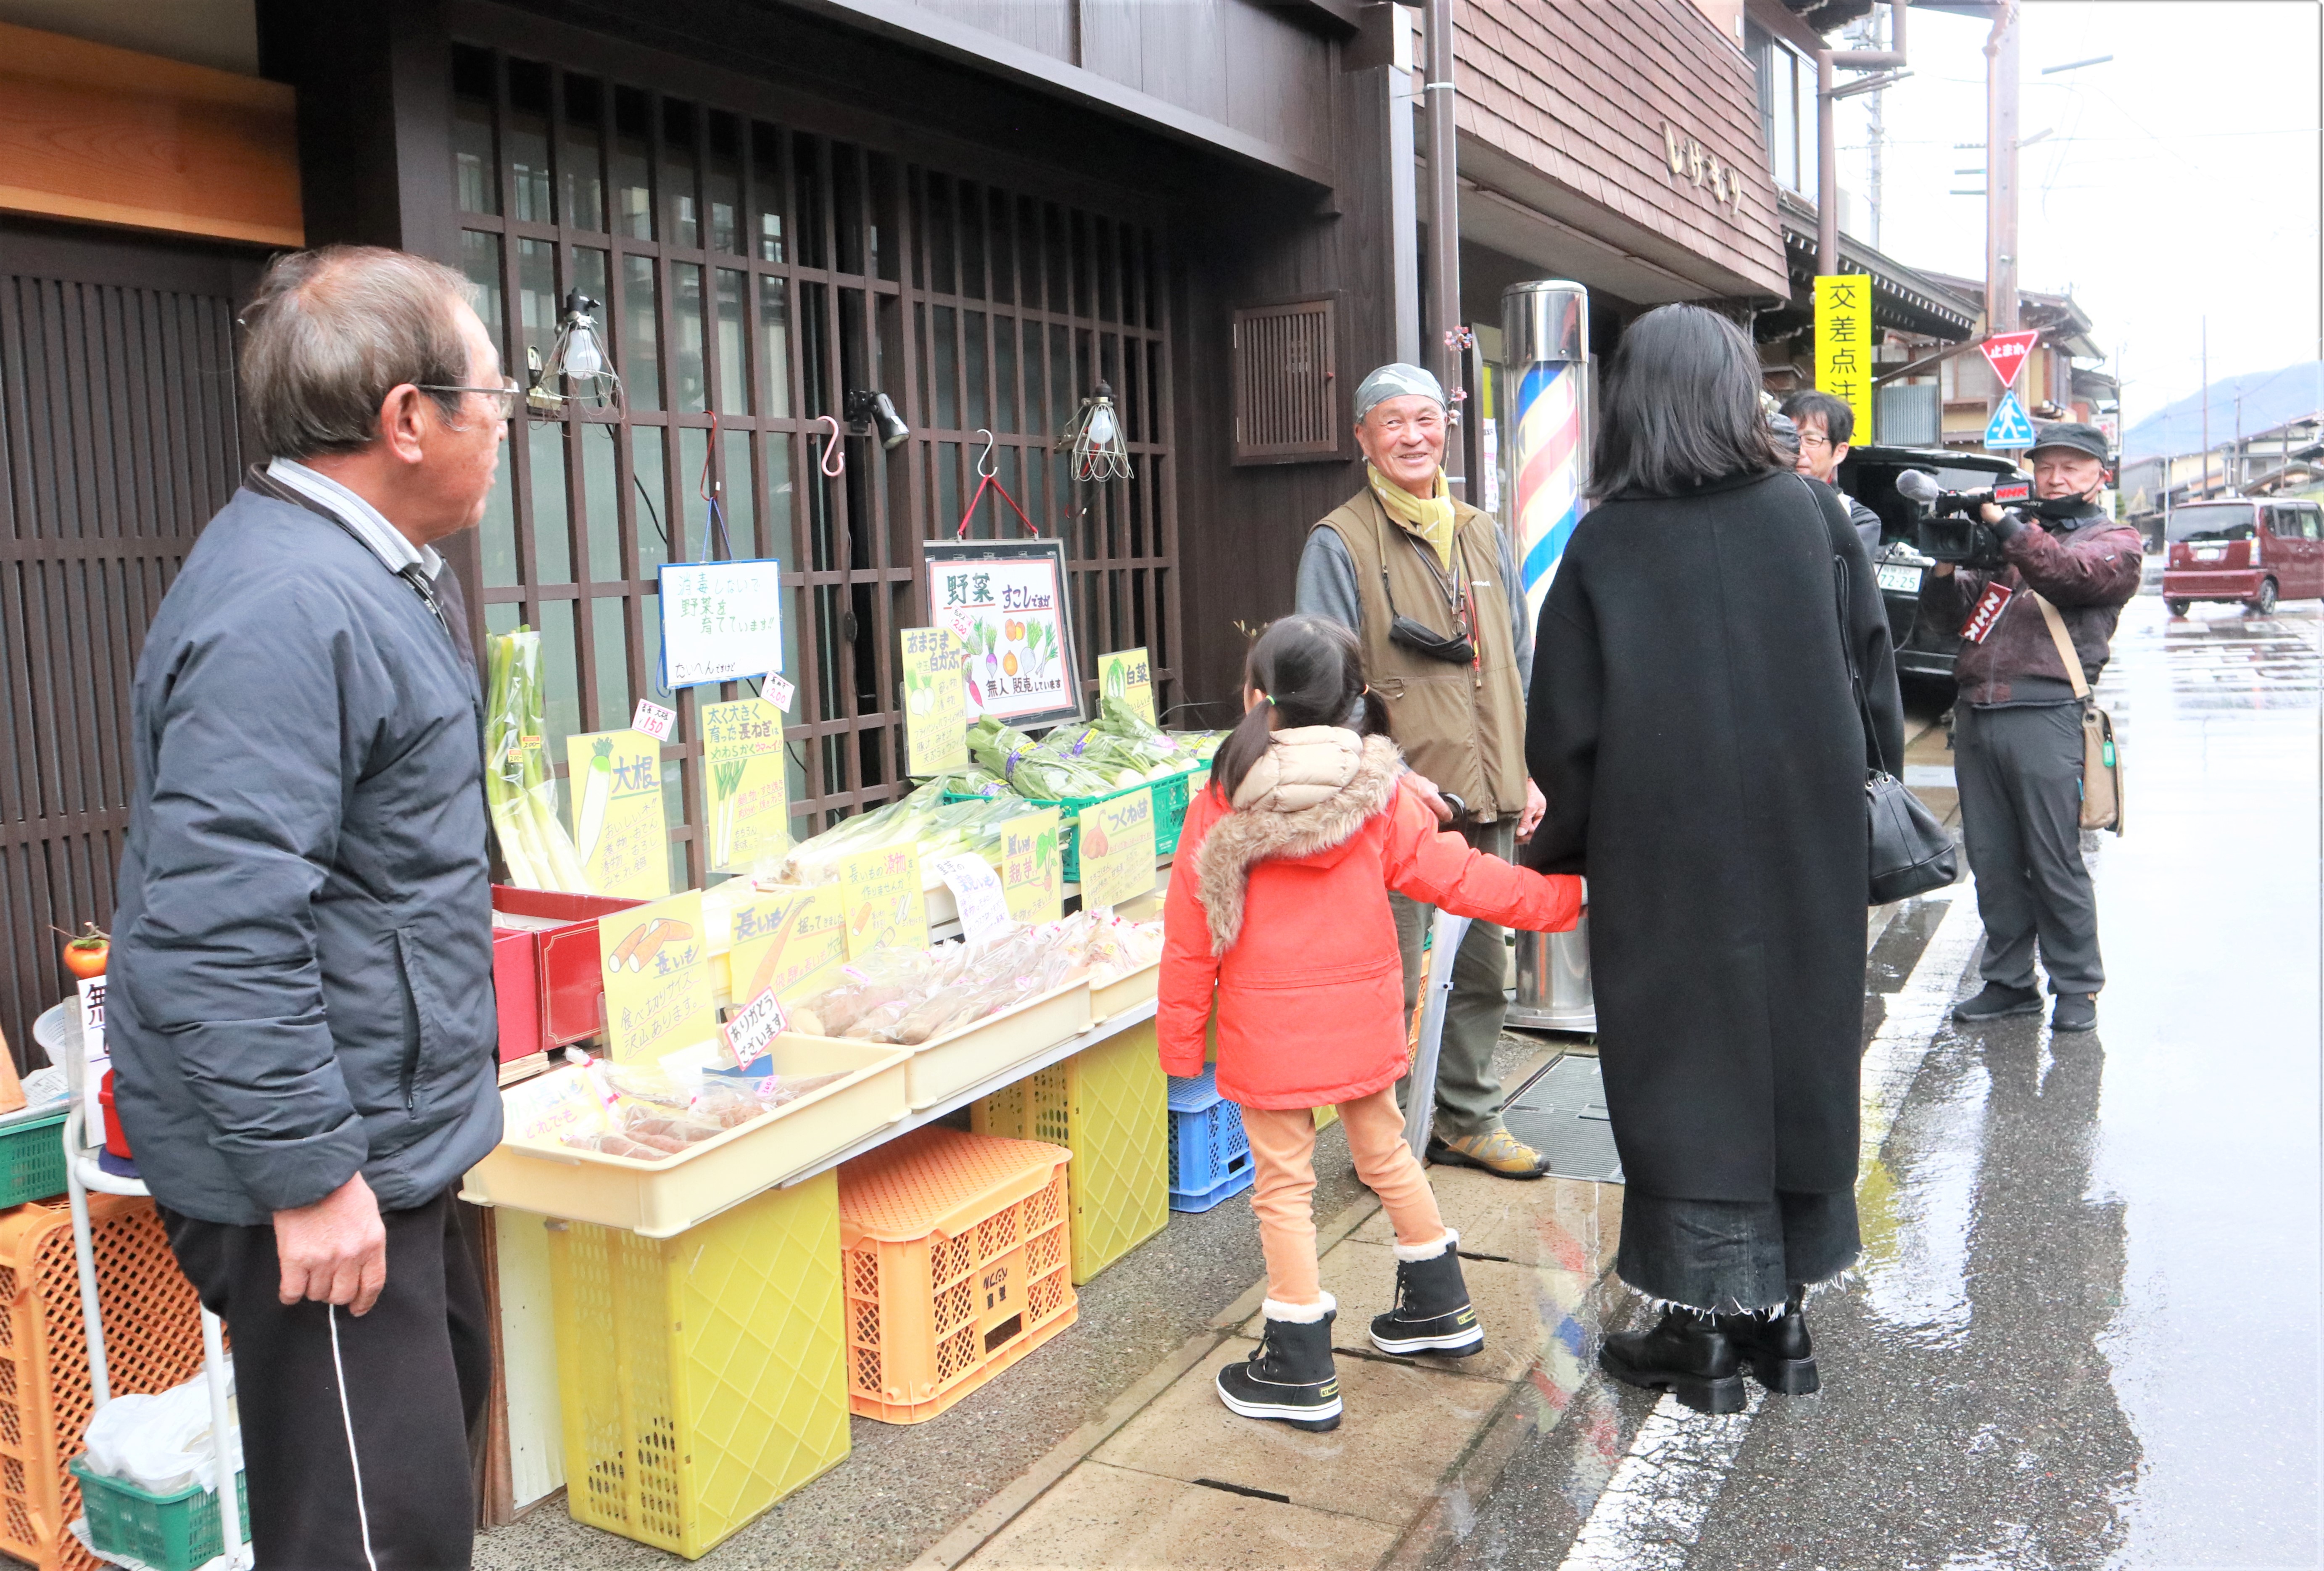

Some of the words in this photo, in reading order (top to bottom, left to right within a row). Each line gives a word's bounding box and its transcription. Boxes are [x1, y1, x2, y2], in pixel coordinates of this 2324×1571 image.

[1989, 342, 2026, 358] 止まれ
[1996, 486, 2029, 499] NHK
[678, 571, 760, 596] 消毒しないで
[947, 573, 994, 605] 野菜
[1880, 574, 1916, 589] 72-25
[680, 596, 727, 618] 野菜を
[1002, 584, 1051, 609] すこしですが
[1965, 591, 2000, 641] NHK
[907, 630, 949, 654] あまうま
[675, 660, 736, 679] たいへんですけど
[930, 648, 960, 673] 白かぶ
[1127, 661, 1150, 685] 白菜
[707, 702, 760, 726] 太く大きく
[708, 720, 780, 744] 育った長ねぎは
[612, 754, 660, 794] 大根
[1108, 797, 1148, 831] つくね芋
[734, 897, 794, 941] 長いも
[655, 945, 700, 975] 長いも
[621, 968, 694, 1031] 食べ切りサイズ
[731, 994, 773, 1043] ありがとう
[740, 1013, 781, 1064] ございます
